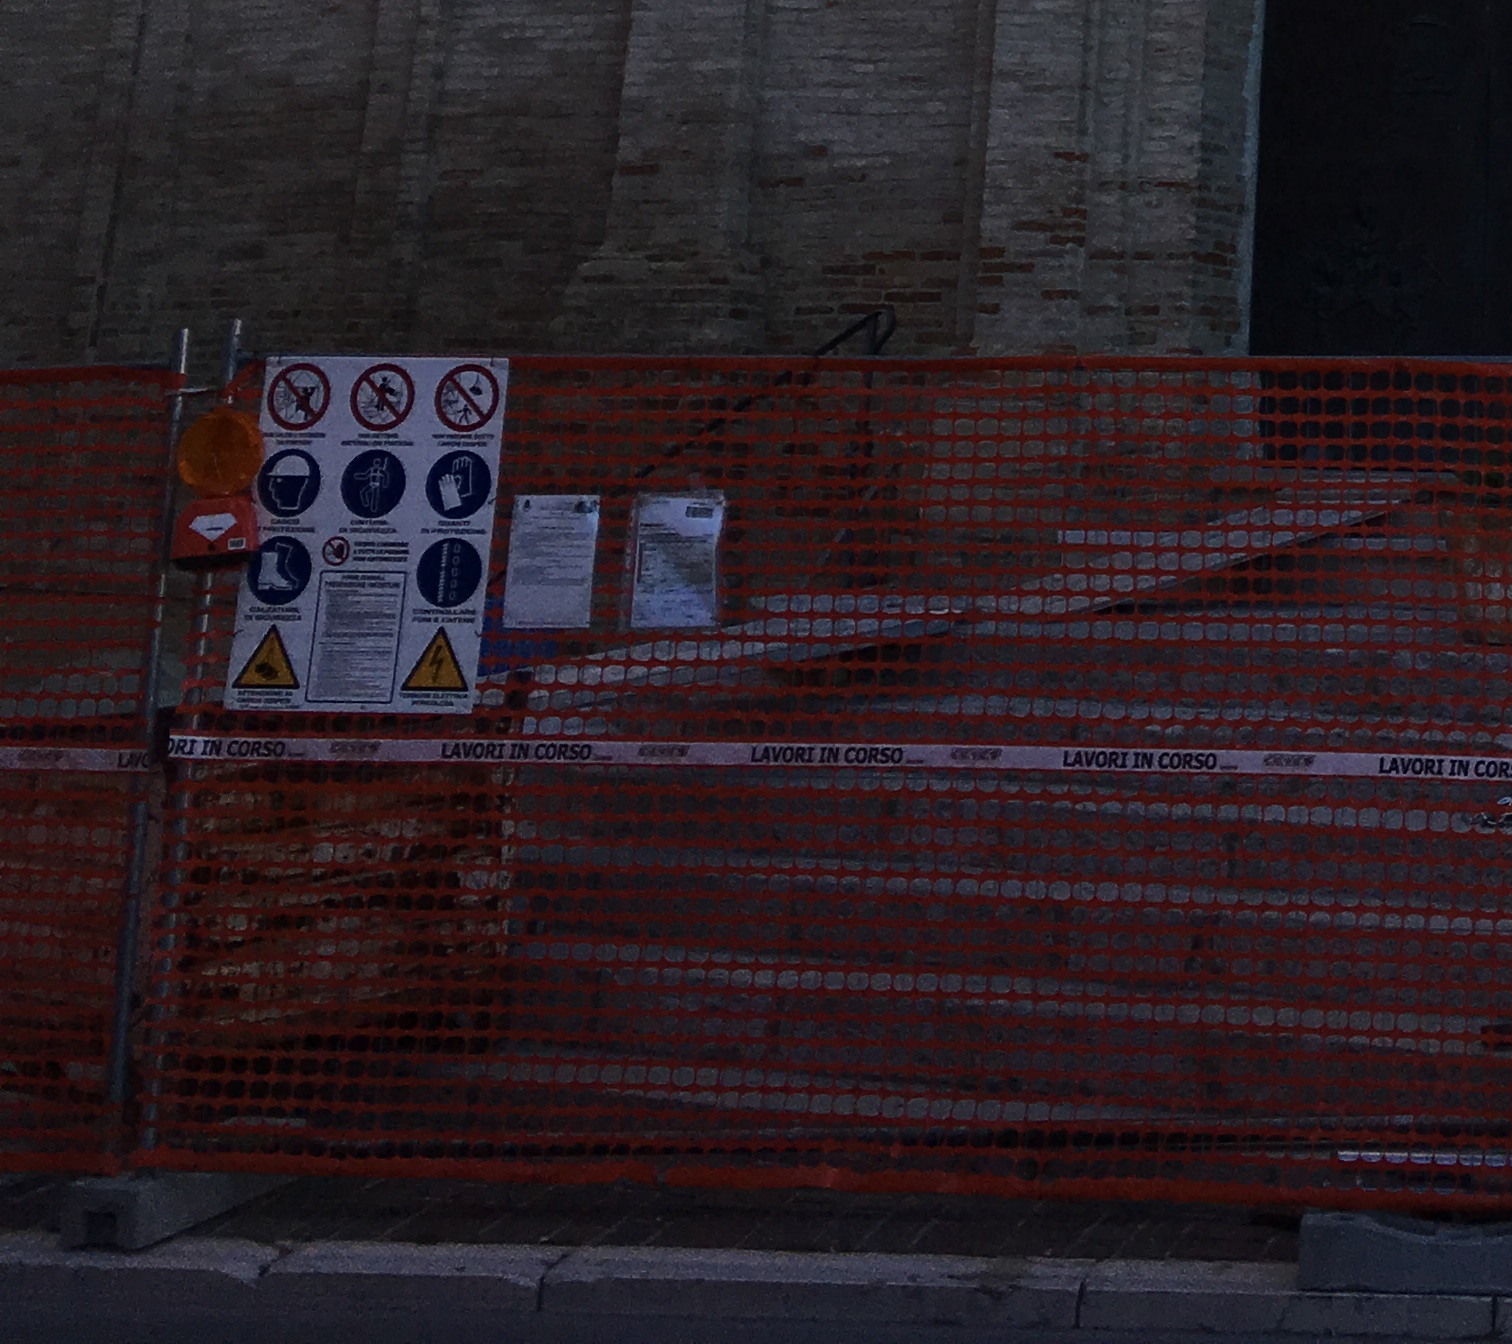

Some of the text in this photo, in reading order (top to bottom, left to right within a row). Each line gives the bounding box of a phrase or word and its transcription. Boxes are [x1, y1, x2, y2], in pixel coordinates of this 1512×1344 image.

[201, 739, 222, 757] IN
[226, 740, 285, 758] CORSO
[441, 742, 506, 759] LAVORI
[509, 743, 530, 759] IN
[534, 743, 592, 760] CORSO
[751, 746, 815, 764] LAVORI
[818, 747, 840, 763] IN
[844, 747, 904, 764] CORSO
[1063, 751, 1128, 768] LAVORI
[1132, 752, 1154, 769] IN
[1158, 752, 1217, 770] CORSO
[1379, 757, 1445, 776] LAVORI
[1449, 759, 1470, 776] IN
